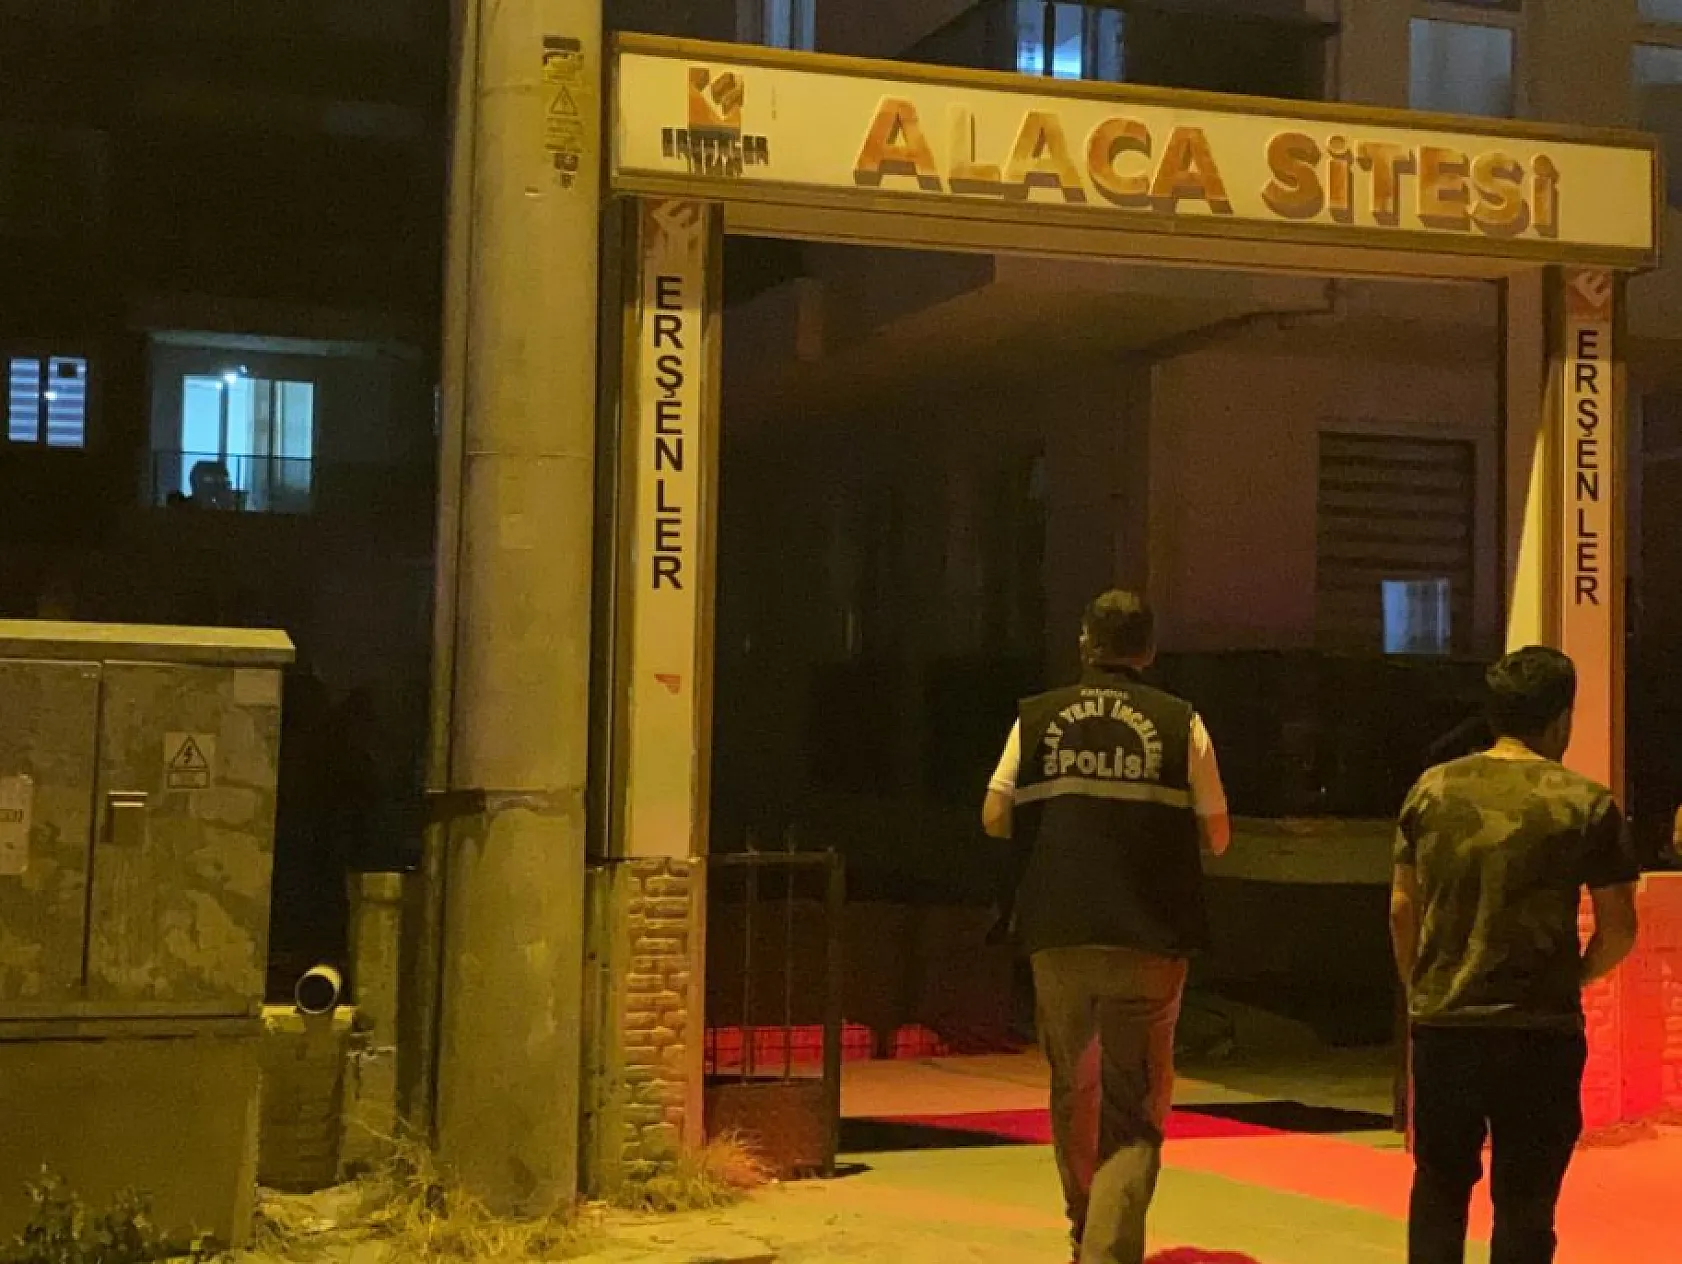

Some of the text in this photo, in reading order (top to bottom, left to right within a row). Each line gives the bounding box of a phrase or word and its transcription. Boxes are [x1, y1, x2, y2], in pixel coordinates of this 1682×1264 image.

[853, 94, 1233, 215] ALACA
[652, 275, 685, 590] ERŞENLER
[1575, 329, 1600, 606] ERŞENLER
[1058, 746, 1143, 780] POLİS
